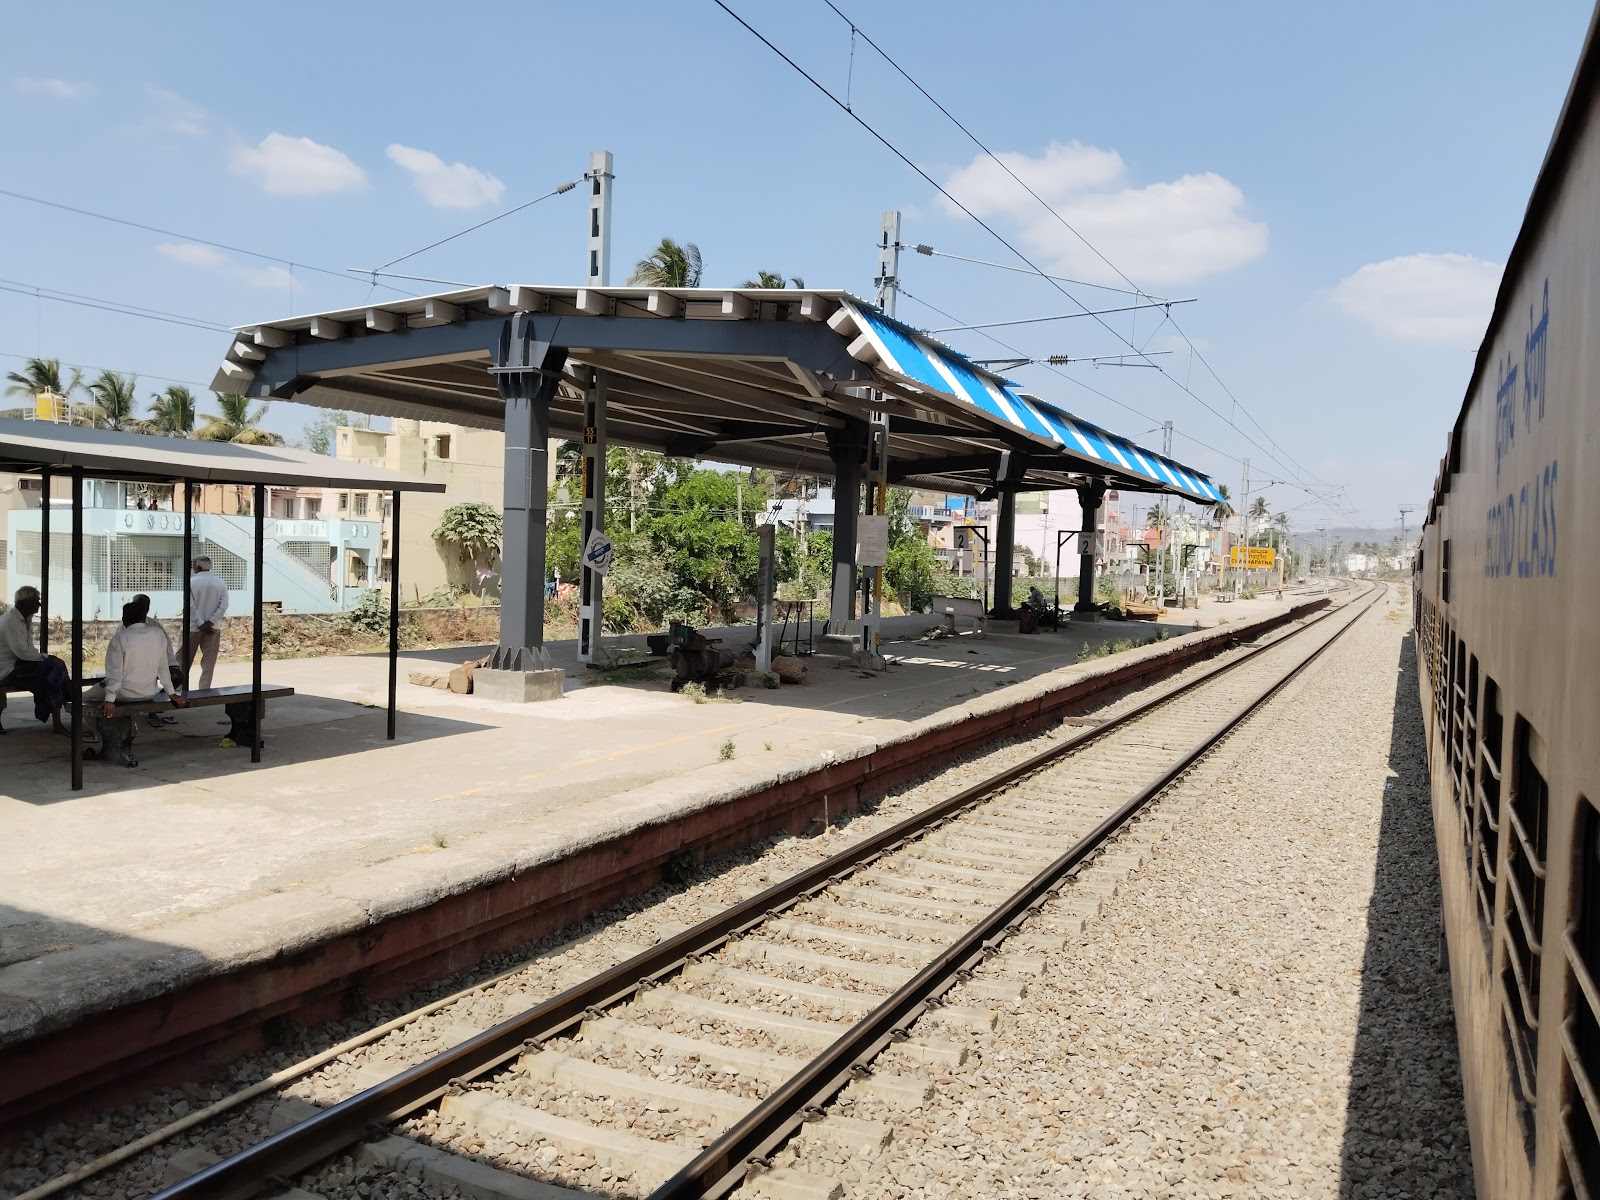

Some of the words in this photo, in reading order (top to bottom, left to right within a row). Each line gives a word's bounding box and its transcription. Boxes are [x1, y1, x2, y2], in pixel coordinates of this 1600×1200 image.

[1518, 459, 1558, 578] CLASS
[958, 534, 964, 548] 2
[1082, 540, 1089, 554] 2
